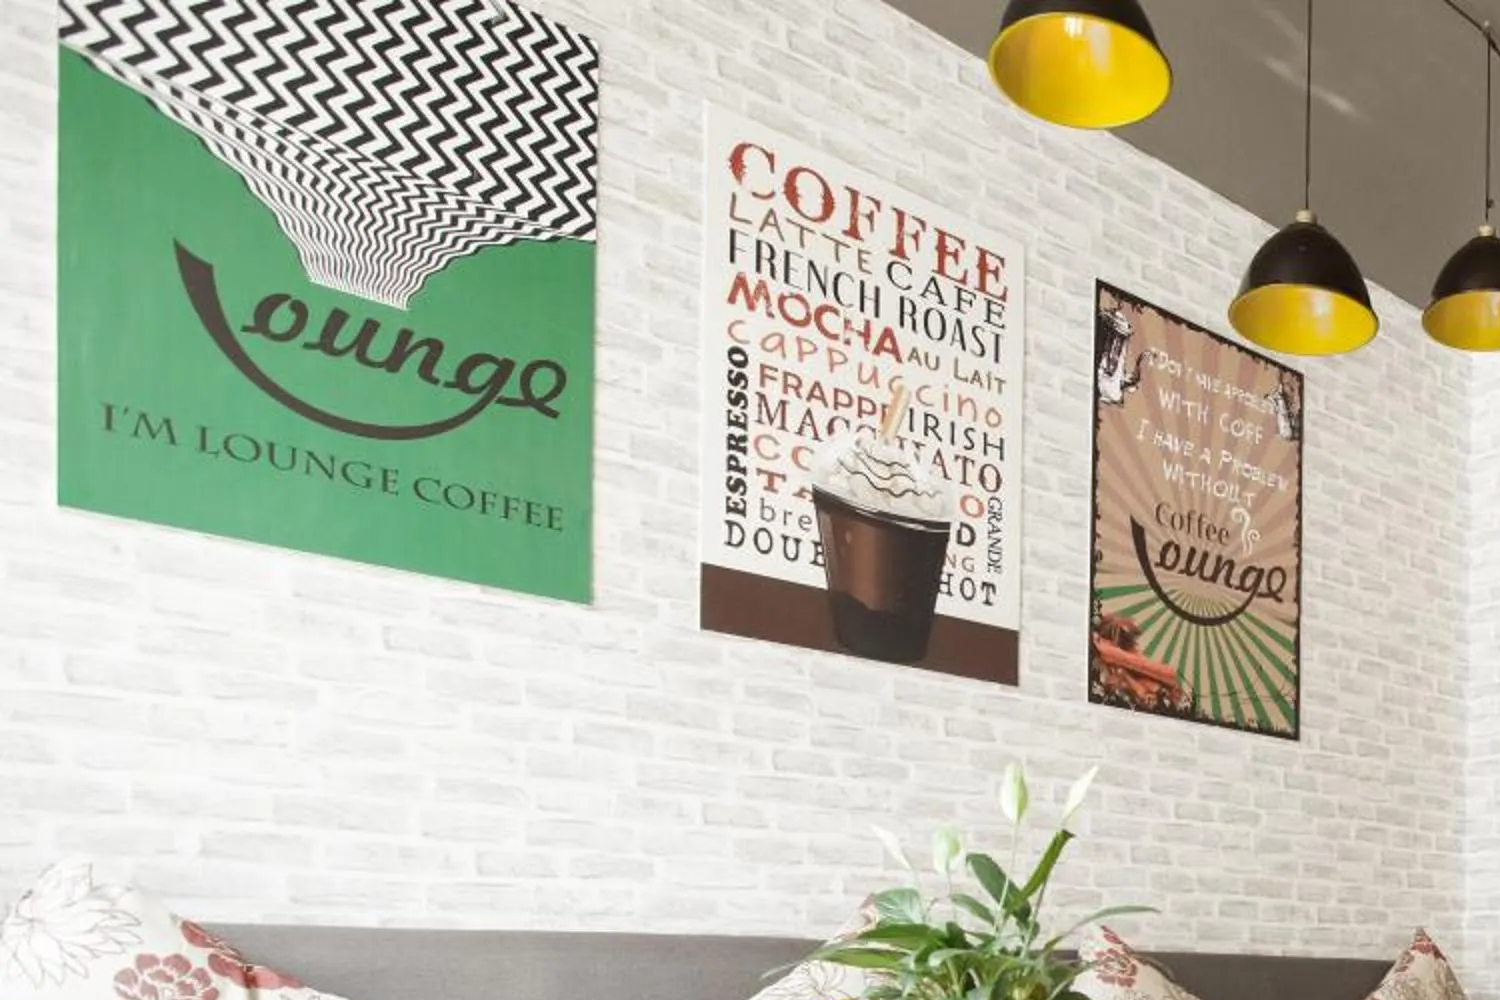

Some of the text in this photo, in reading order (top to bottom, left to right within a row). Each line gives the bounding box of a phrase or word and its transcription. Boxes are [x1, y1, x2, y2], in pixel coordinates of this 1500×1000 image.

[727, 141, 1008, 303] COFFEE
[729, 191, 873, 275] LATTE
[727, 271, 1007, 395] MOCHA AU LAIT
[729, 228, 1002, 364] FRENCH ROAST
[725, 345, 749, 518] ESPRESSO
[908, 407, 1005, 461] IRISH
[1136, 418, 1150, 441] I
[1152, 430, 1196, 457] HAVE
[1200, 447, 1212, 465] A
[1157, 387, 1210, 425] WITH
[101, 402, 564, 533] I'M LOUNGE COFFEE
[1161, 460, 1258, 507] WITHOUT
[724, 519, 827, 567] DOUB
[987, 496, 1003, 575] GRANDE
[1155, 502, 1232, 546] Coffee
